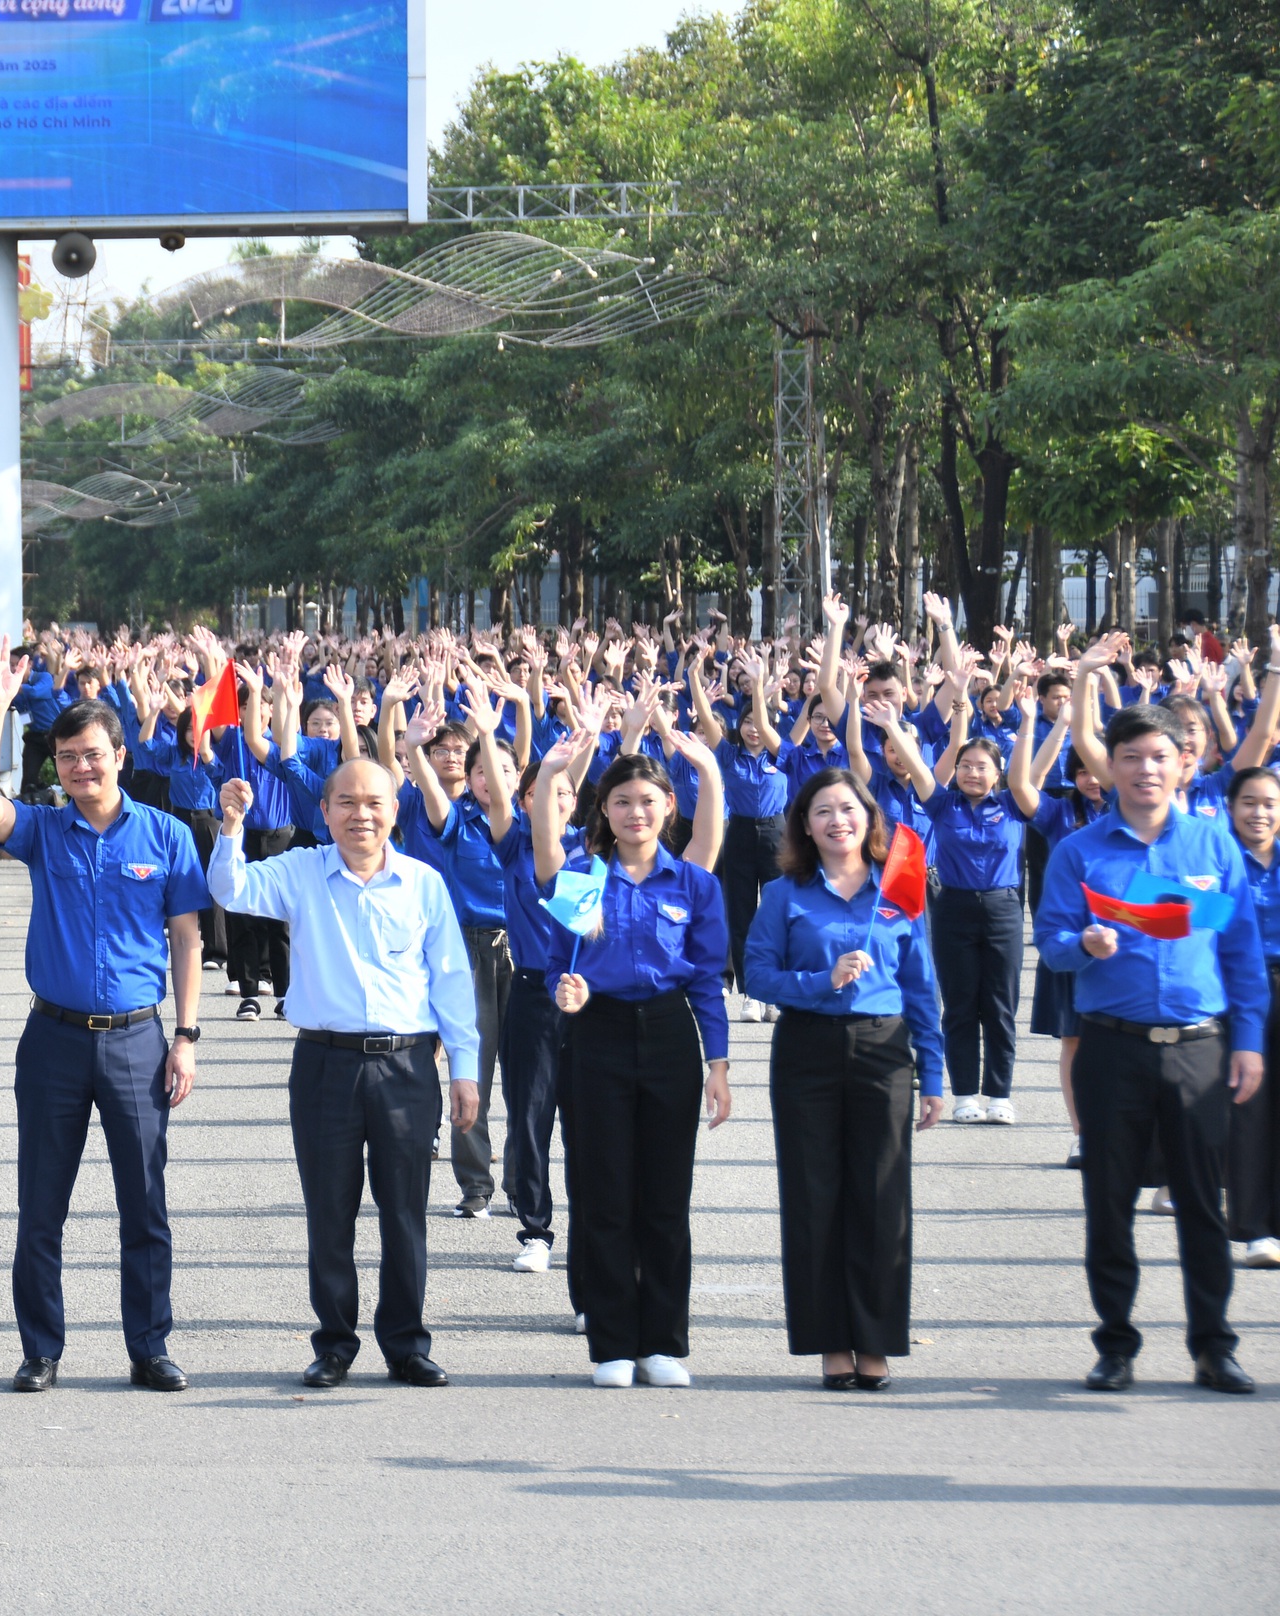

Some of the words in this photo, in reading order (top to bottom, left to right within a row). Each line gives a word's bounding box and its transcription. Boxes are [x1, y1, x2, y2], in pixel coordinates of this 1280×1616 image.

[22, 60, 57, 71] 2025
[13, 97, 40, 110] các
[44, 96, 69, 112] địa
[42, 116, 68, 129] Chí
[73, 116, 111, 129] Minh
